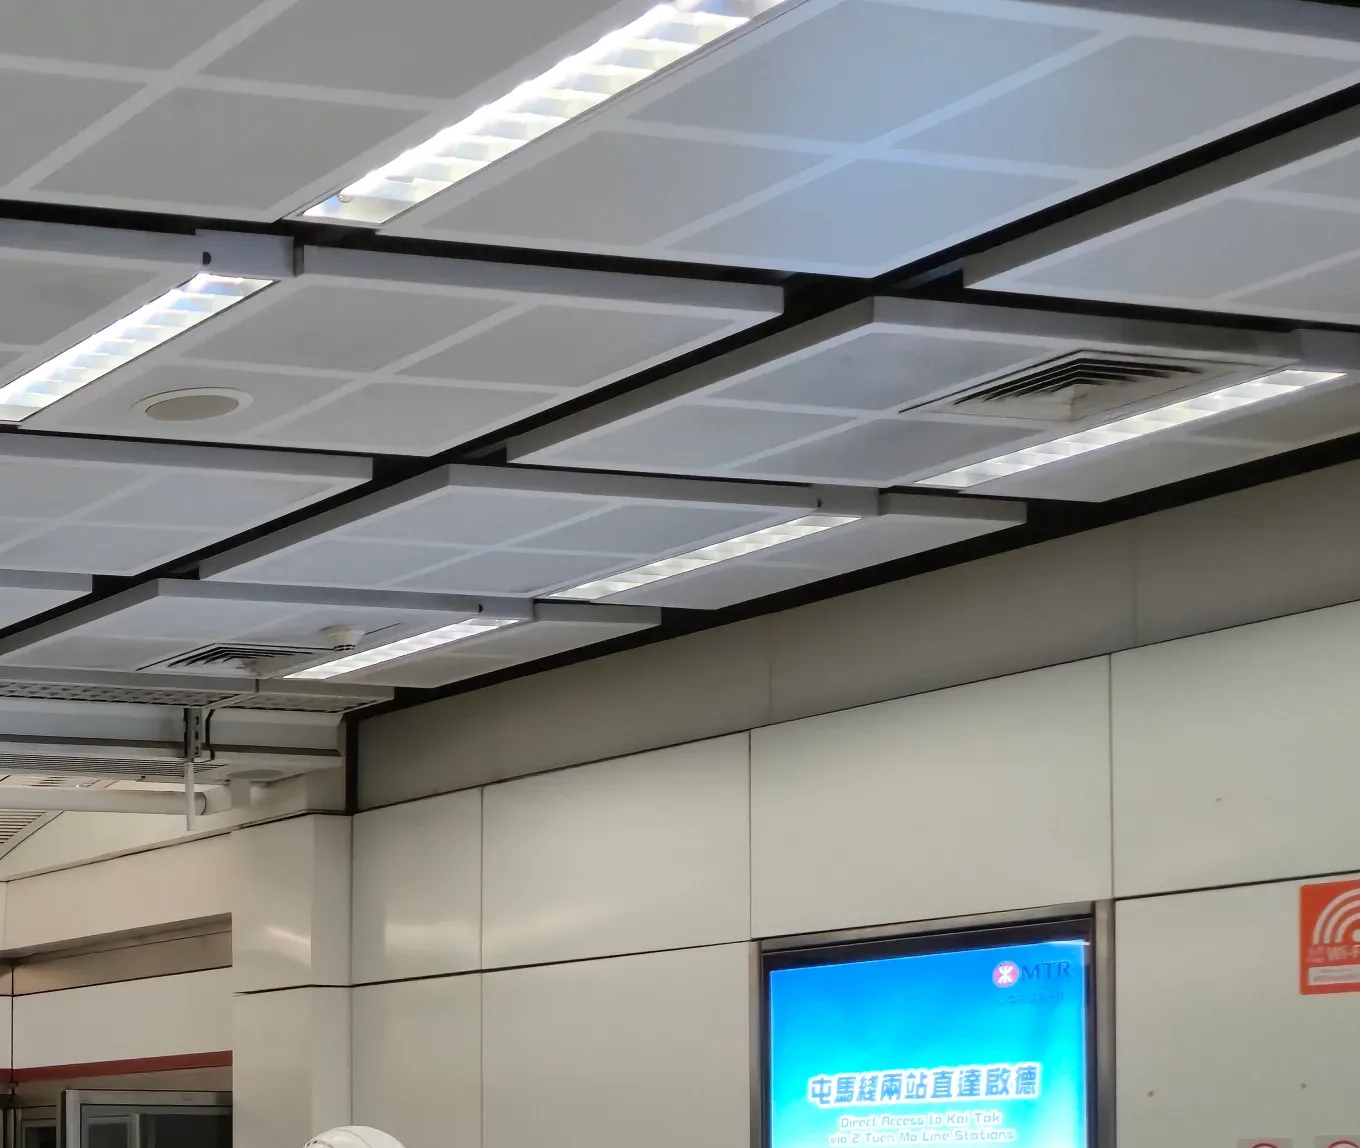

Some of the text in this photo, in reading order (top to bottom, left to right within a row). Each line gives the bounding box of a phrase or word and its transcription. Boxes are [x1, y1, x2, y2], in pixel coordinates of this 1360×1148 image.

[1021, 961, 1073, 981] MTR
[810, 1064, 1038, 1105] 屯馬綫兩站直達啟德
[840, 1111, 1001, 1129] Direct Access to Kai Tak
[830, 1129, 1015, 1145] via 2 Tuen Ma Line Stations
